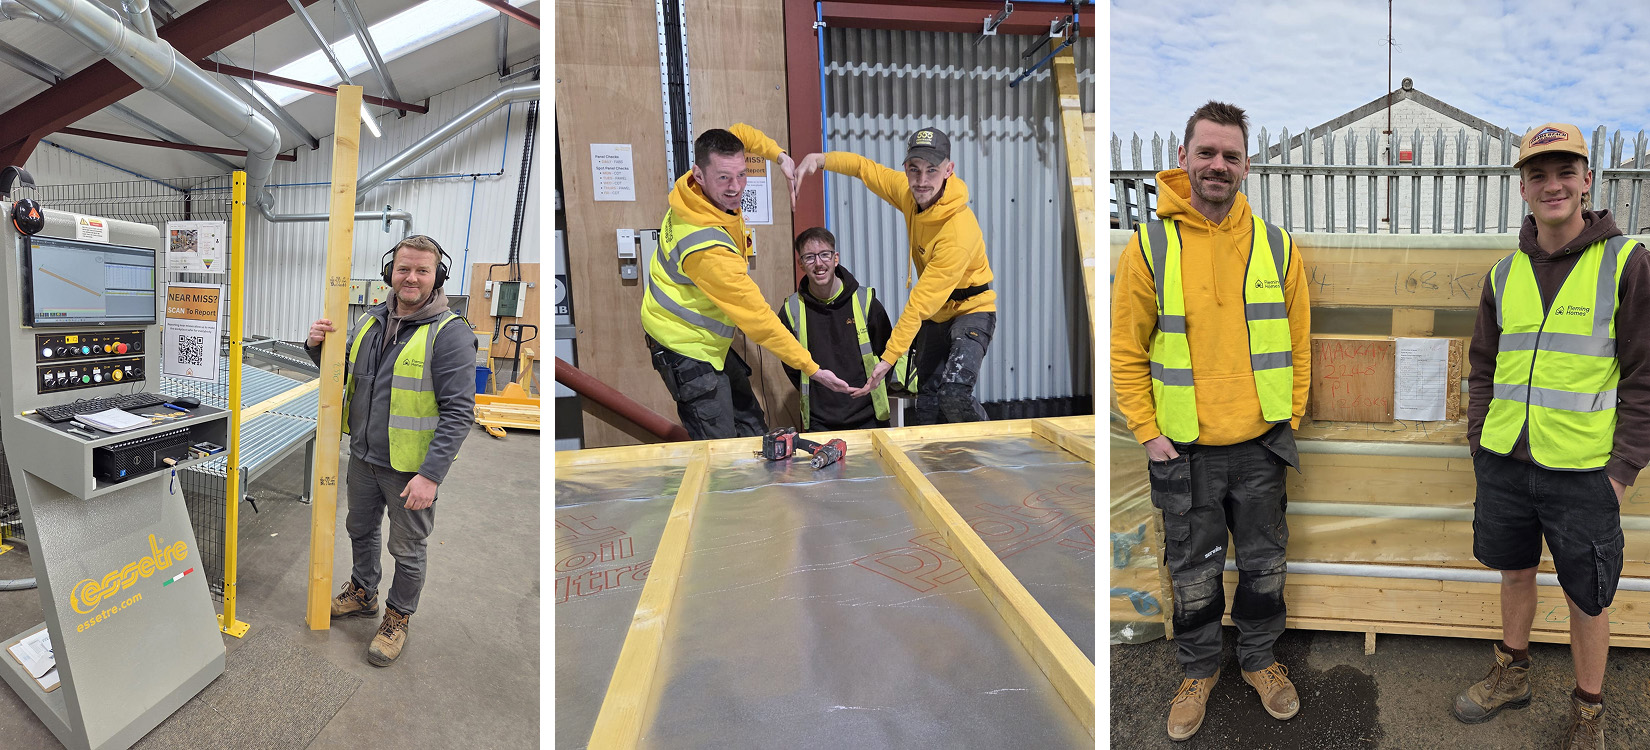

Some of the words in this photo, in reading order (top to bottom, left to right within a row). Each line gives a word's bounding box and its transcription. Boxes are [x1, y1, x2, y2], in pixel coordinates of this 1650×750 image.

[169, 293, 191, 302] NEAR
[192, 294, 218, 303] MISS?
[168, 306, 185, 314] SCAN
[195, 308, 216, 317] Report
[1567, 305, 1590, 313] Fleming
[1320, 342, 1389, 363] MACKAY
[70, 533, 188, 614] essetre
[76, 592, 143, 633] essetre.com
